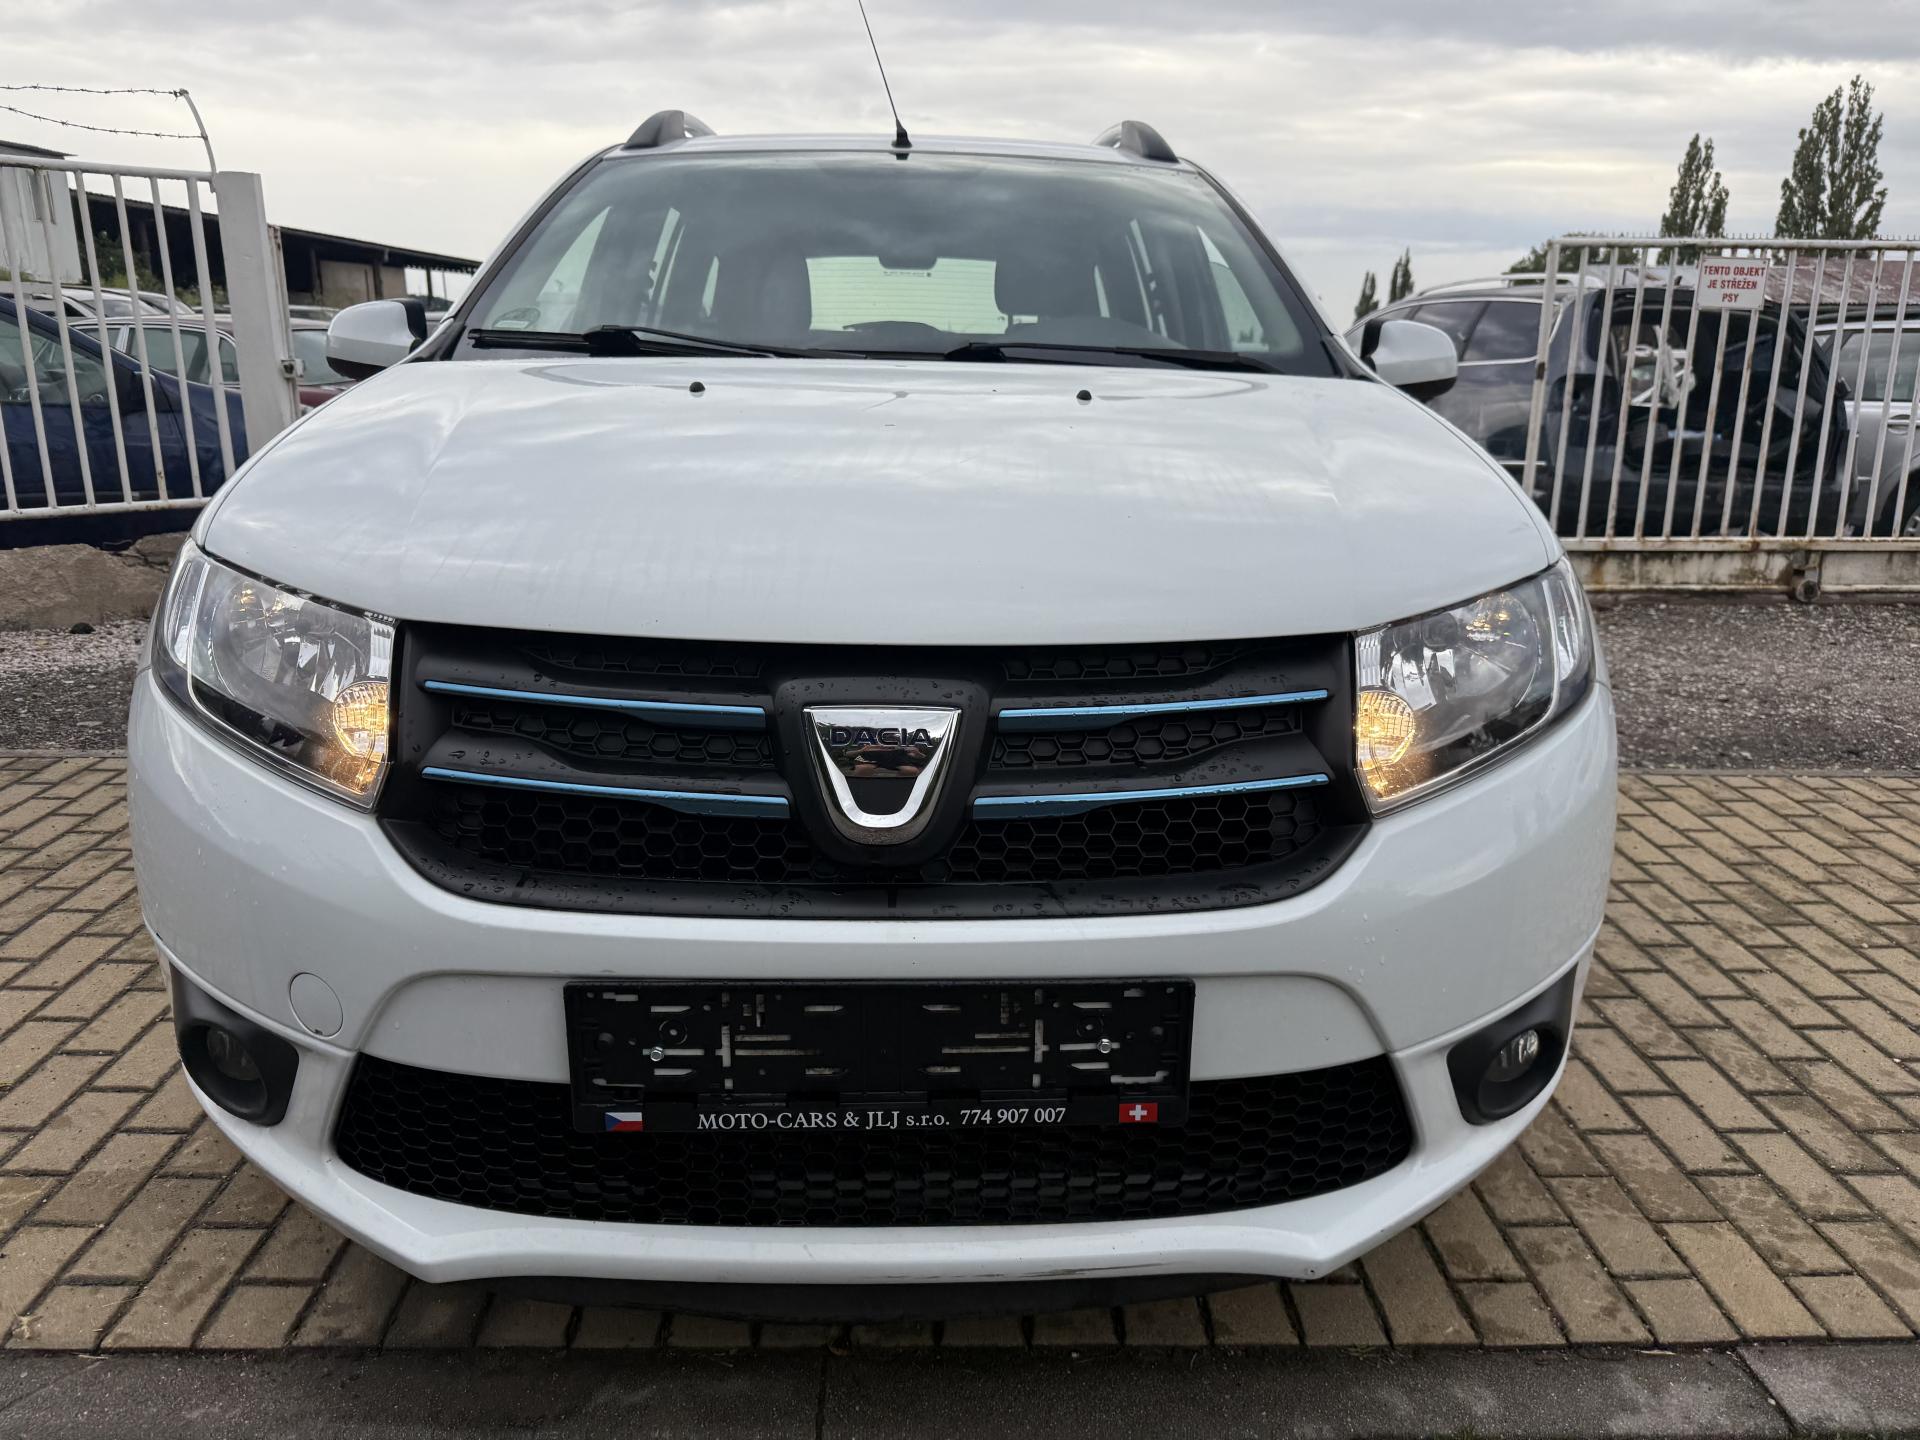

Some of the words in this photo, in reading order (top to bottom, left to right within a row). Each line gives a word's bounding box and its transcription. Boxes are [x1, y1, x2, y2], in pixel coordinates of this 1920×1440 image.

[1704, 265, 1730, 275] TENTO
[1733, 266, 1765, 276] OBJEKT
[1707, 279, 1718, 289] JE
[1720, 278, 1757, 289] STŘEŽEN
[1721, 293, 1739, 303] PSY
[830, 727, 933, 748] DACIA
[697, 1112, 837, 1130] MOTO-CARS
[843, 1111, 860, 1127] &
[865, 1110, 900, 1130] JLJ
[906, 1114, 950, 1127] s.r.o.
[960, 1107, 992, 1125] 774
[997, 1106, 1029, 1124] 907
[1034, 1105, 1066, 1124] 007
